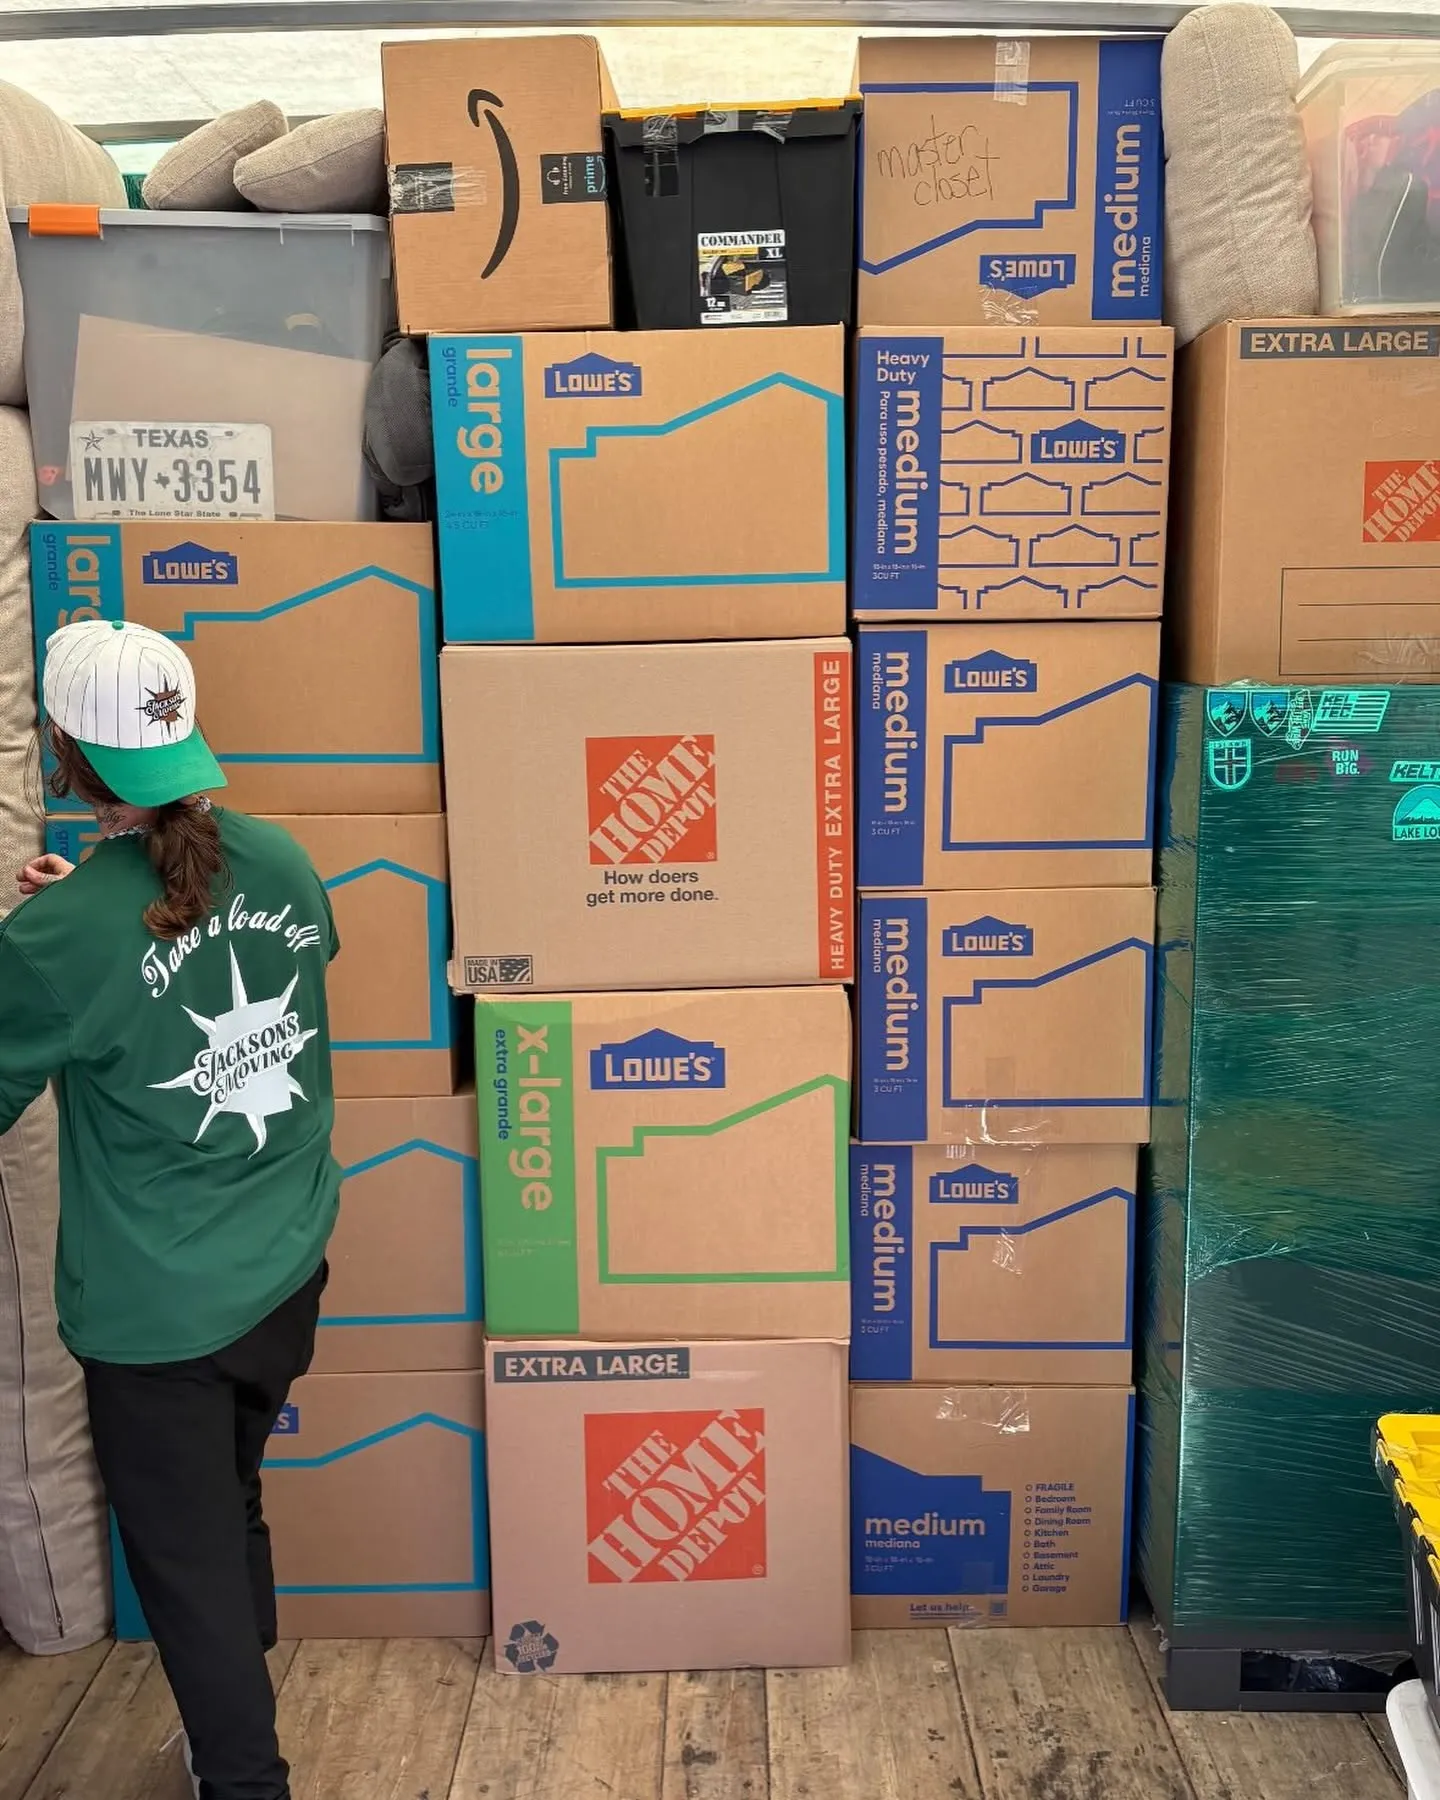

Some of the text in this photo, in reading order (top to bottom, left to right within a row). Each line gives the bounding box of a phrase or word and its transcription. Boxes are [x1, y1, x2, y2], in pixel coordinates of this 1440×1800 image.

[877, 114, 978, 179] master
[584, 155, 598, 193] prime
[913, 138, 1000, 206] closet
[1105, 124, 1142, 298] medium
[701, 233, 782, 247] COMMANDER
[766, 248, 783, 259] XL
[990, 260, 1066, 281] LOWE'S
[1140, 235, 1152, 297] mediana
[1250, 331, 1429, 353] EXTRA LARGE
[876, 350, 930, 368] Heavy
[441, 346, 459, 407] grande
[554, 370, 632, 394] LOWE'S
[876, 367, 916, 385] Duty
[456, 348, 513, 495] large
[132, 428, 209, 448] TEXAS
[1040, 436, 1116, 459] LOWE'S
[84, 457, 261, 504] MWY 3354
[877, 391, 891, 555] Para uso pesado, mediana
[894, 389, 928, 555] medium
[1371, 468, 1406, 502] THE
[174, 510, 194, 518] Star
[197, 510, 221, 518] State
[43, 533, 59, 591] grande
[153, 558, 229, 580] LOWE'S
[871, 652, 881, 710] mediana
[954, 667, 1028, 688] LOWE'S
[1323, 694, 1350, 704] KEL
[884, 651, 918, 812] medium
[1332, 749, 1359, 761] RUN
[600, 748, 654, 803] THE
[1335, 762, 1360, 775] BIG.
[589, 734, 717, 865] HOME
[639, 782, 716, 864] DEPOT
[822, 659, 845, 971] HEAVY DUTY EXTRA LARGE
[1394, 827, 1421, 839] LAKE
[604, 869, 699, 885] How doers
[586, 889, 616, 907] get
[620, 890, 665, 903] more
[141, 925, 201, 998] Take
[207, 914, 221, 938] a
[228, 893, 292, 933] load
[873, 919, 881, 973] mediana
[952, 931, 1025, 952] LOWE'S
[467, 959, 488, 967] MADE
[468, 966, 498, 983] USA
[886, 918, 919, 1071] medium
[604, 1053, 713, 1083] LOWE'S
[493, 1029, 511, 1141] extra grande
[509, 1024, 563, 1212] x-large
[860, 1164, 869, 1217] mediana
[939, 1179, 1009, 1199] LOWE'S
[872, 1163, 905, 1312] medium
[505, 1353, 679, 1377] EXTRA LARGE
[602, 1429, 680, 1501] THE
[587, 1408, 766, 1583] HOME
[1035, 1483, 1075, 1491] FRAGILE
[1034, 1505, 1092, 1516] Family Room
[1035, 1495, 1076, 1503] Bedroom
[658, 1472, 766, 1582] DEPOT
[864, 1512, 986, 1536] medium
[1034, 1517, 1091, 1527] Dining Room
[1034, 1529, 1069, 1537] Kitchen
[865, 1538, 921, 1549] mediana
[1033, 1540, 1056, 1548] Bath
[1033, 1551, 1079, 1559] Basement
[1033, 1562, 1055, 1570] Attic
[1032, 1574, 1070, 1582] Laundry
[1032, 1584, 1067, 1593] Garage
[910, 1603, 927, 1612] Let
[930, 1604, 942, 1612] us
